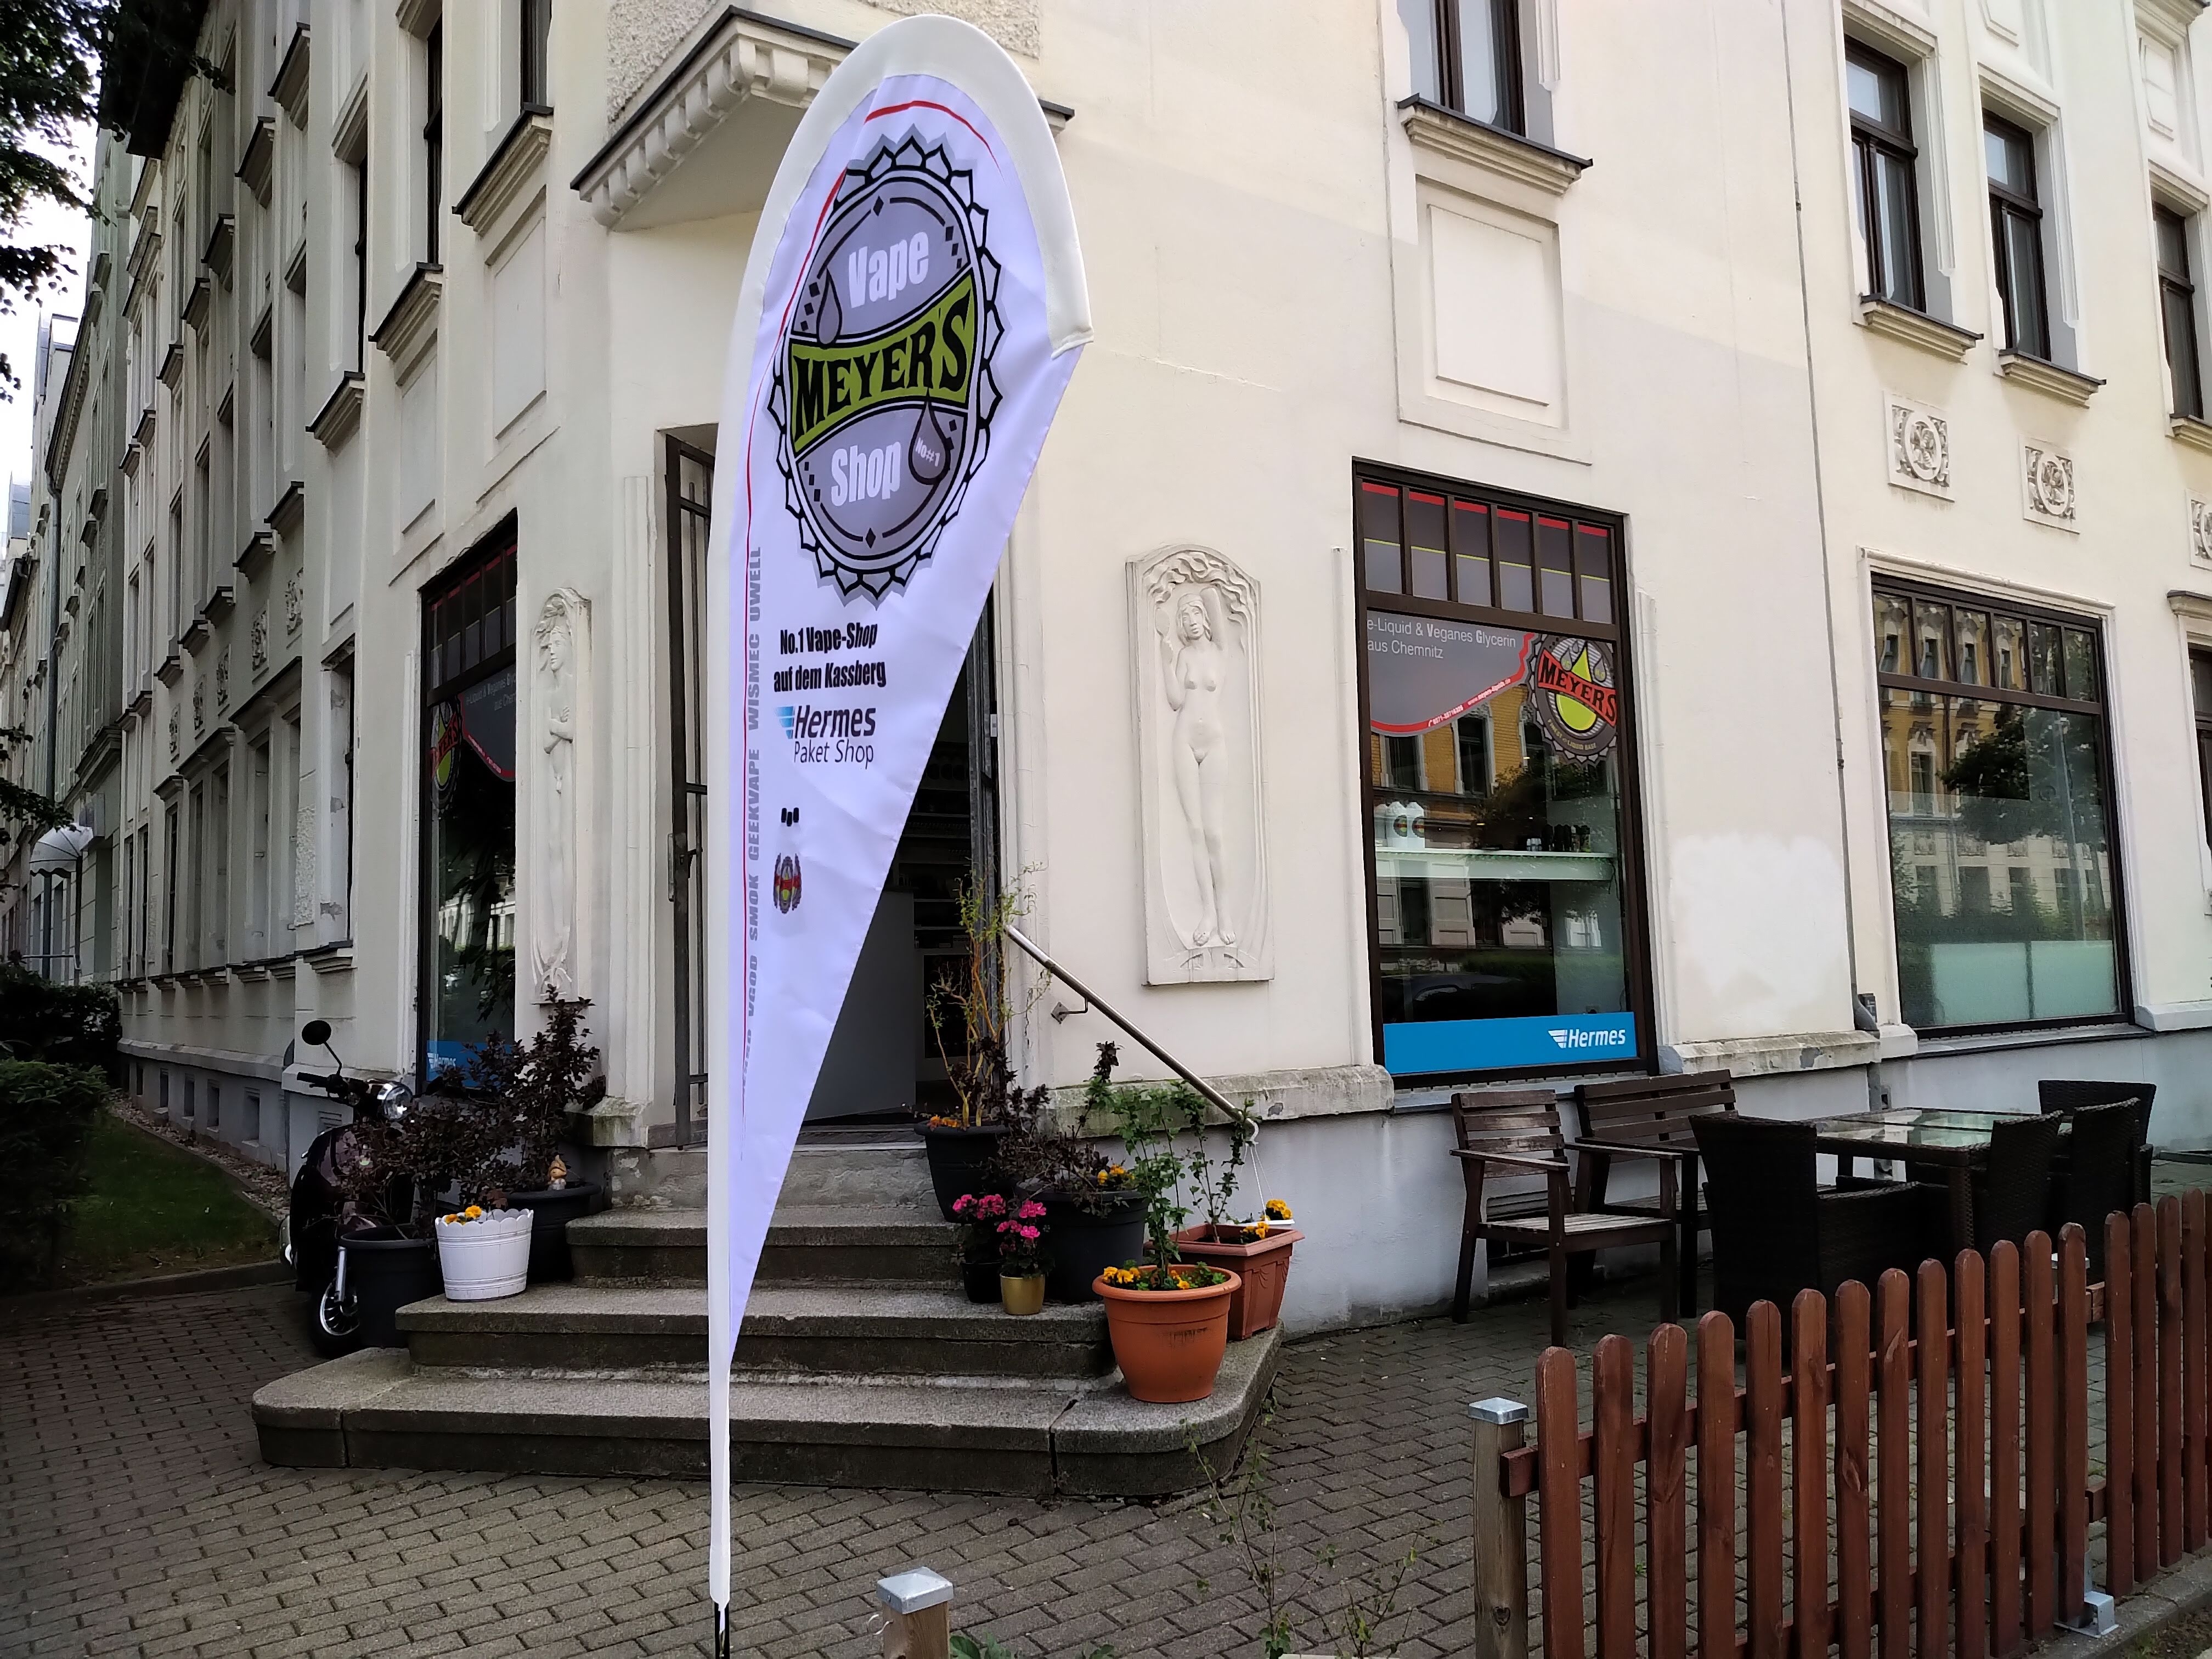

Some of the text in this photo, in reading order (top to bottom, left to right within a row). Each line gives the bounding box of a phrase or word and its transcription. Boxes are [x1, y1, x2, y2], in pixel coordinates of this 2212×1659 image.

[848, 231, 929, 308] Vape
[793, 289, 971, 437] MEYER'S
[831, 441, 901, 507] Shop
[780, 622, 878, 655] No.1 Vape-Shop
[1367, 617, 1516, 648] e-Liquid & Veganes Glycerin
[1367, 640, 1444, 659] aus Chemnitz
[774, 659, 887, 692] auf dem Kassberg
[795, 705, 876, 739] Hermes
[794, 738, 874, 769] Paket Shop
[748, 546, 761, 1017] VGOD SMOK GEEKVAPE WISMEC UWELL
[1568, 1028, 1626, 1048] Hermes
